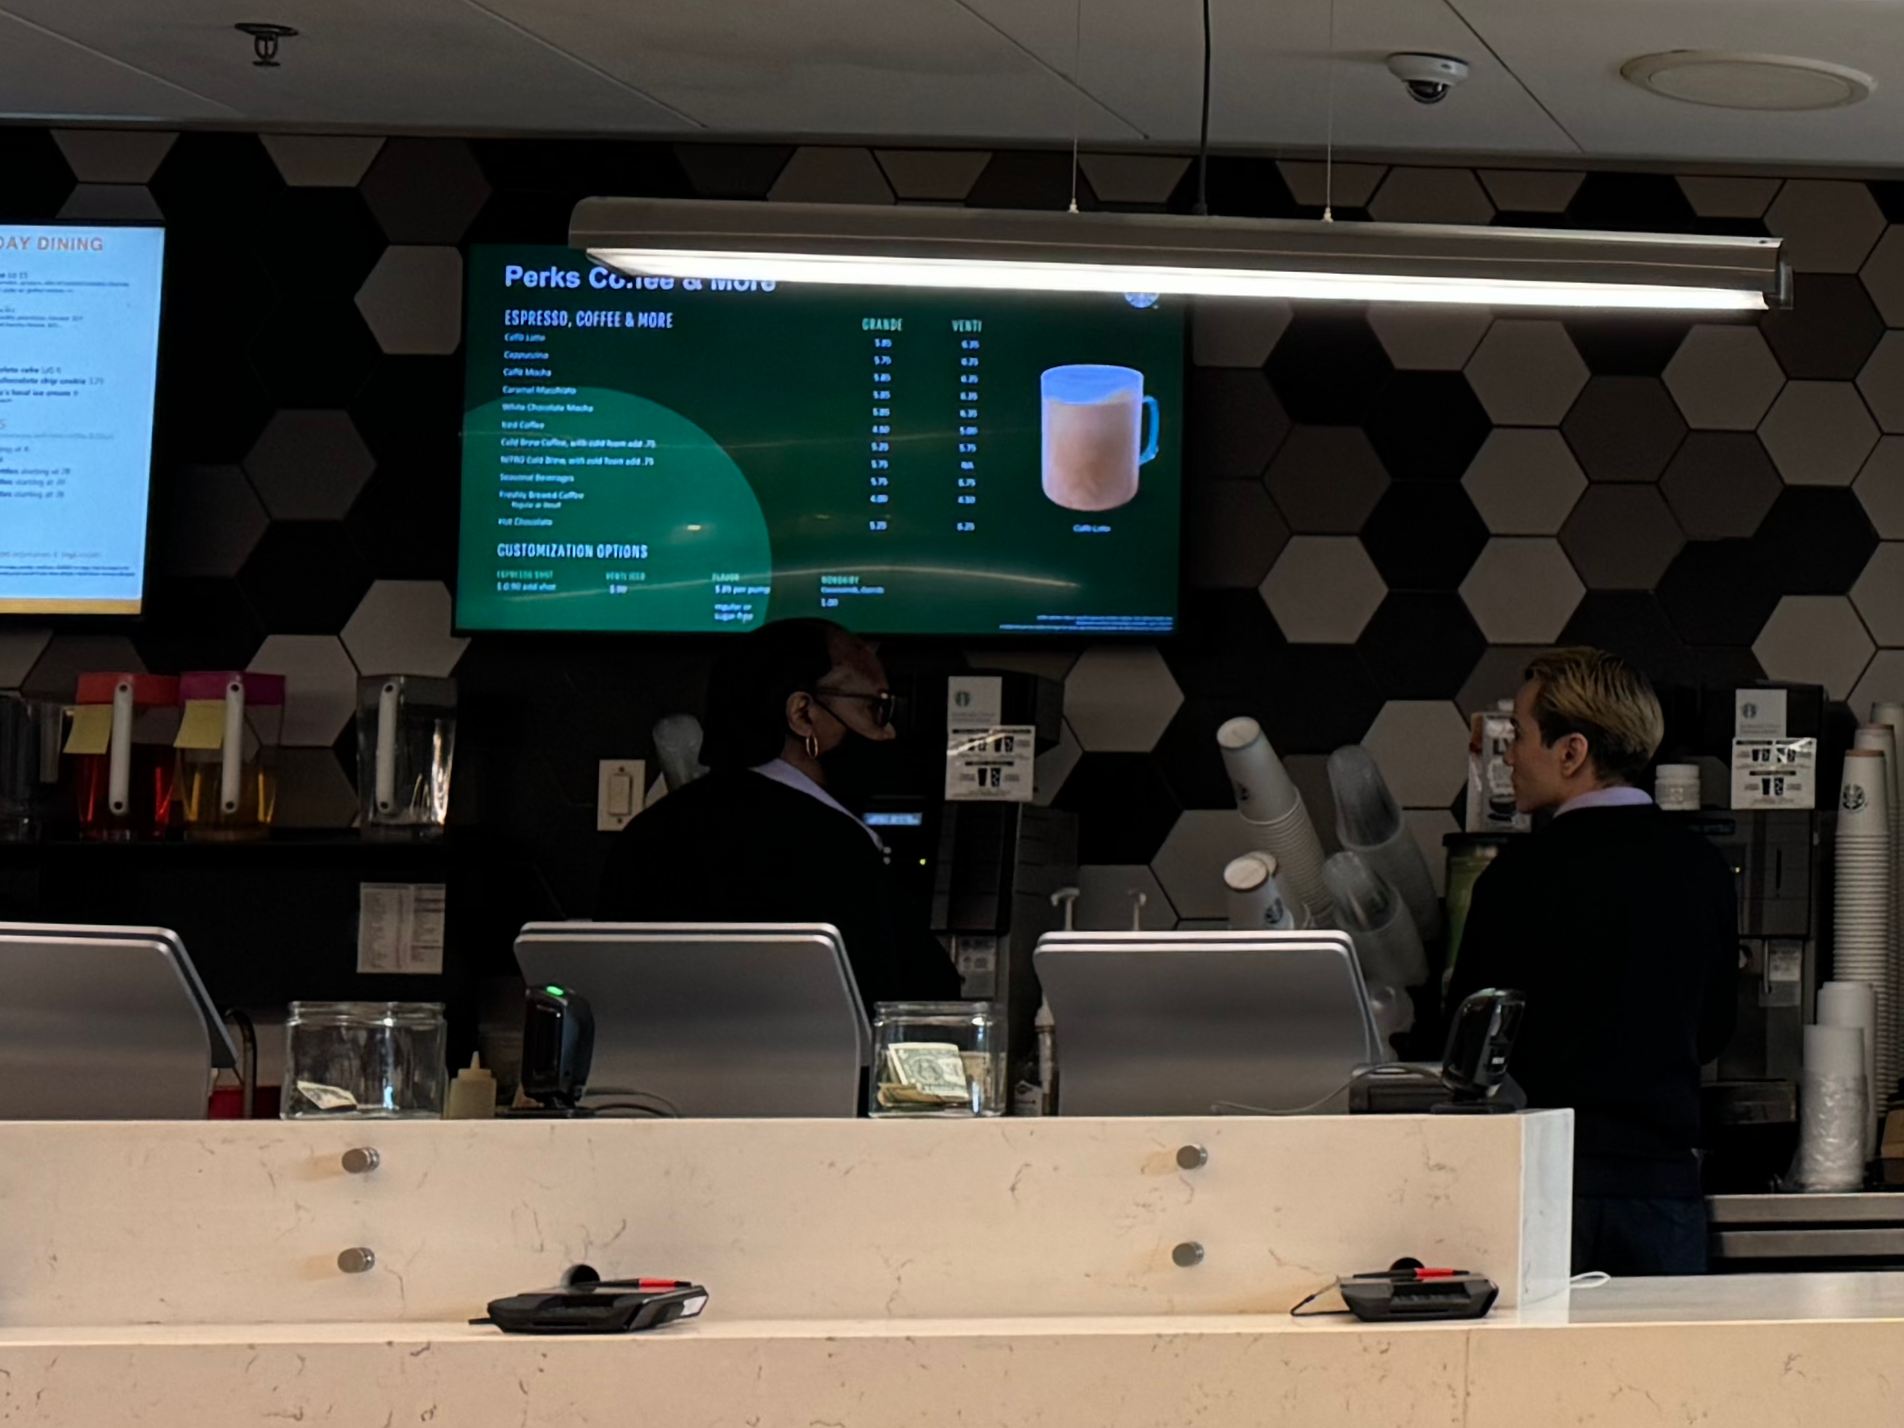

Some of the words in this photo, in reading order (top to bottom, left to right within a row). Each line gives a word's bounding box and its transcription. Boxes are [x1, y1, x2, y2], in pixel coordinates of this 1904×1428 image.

[37, 237, 103, 251] DINING
[505, 265, 580, 289] Perks
[589, 267, 675, 291] Coee
[504, 310, 572, 328] ESPRESSO,
[576, 310, 621, 327] COFFEE
[638, 312, 673, 328] MORE
[862, 318, 903, 331] GRANDE
[952, 320, 983, 332] VENTI
[497, 543, 593, 558] CUSTOMIZATION
[597, 544, 648, 559] OPTIONS
